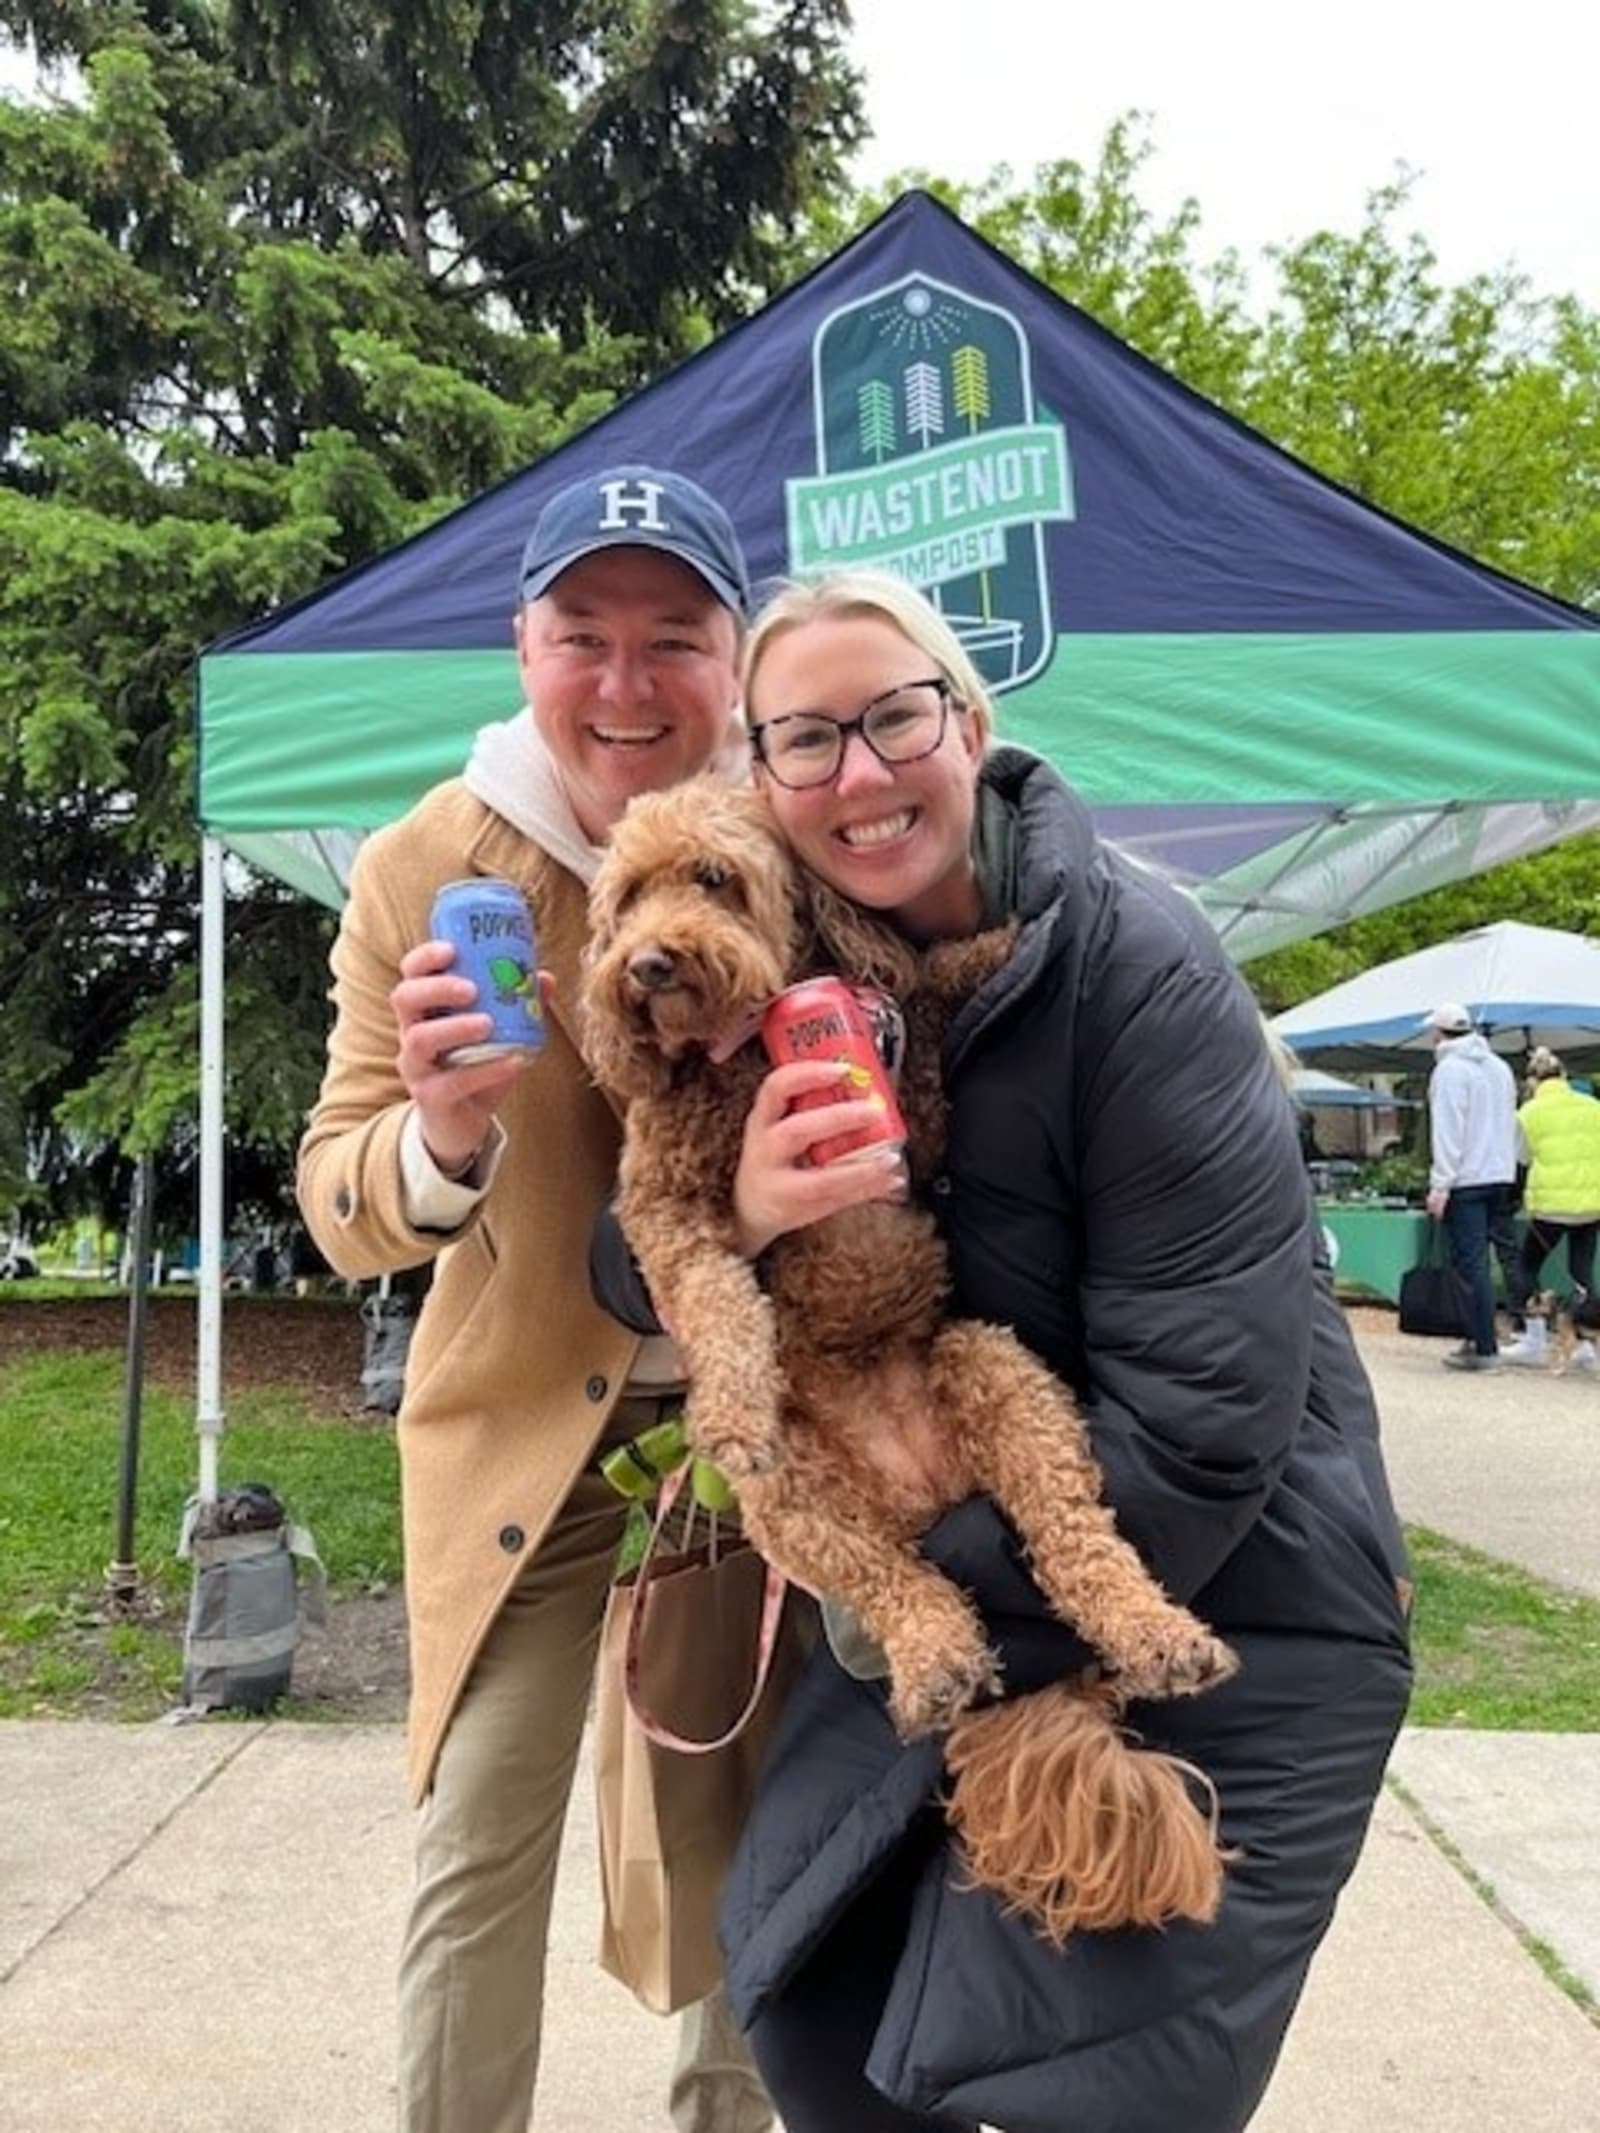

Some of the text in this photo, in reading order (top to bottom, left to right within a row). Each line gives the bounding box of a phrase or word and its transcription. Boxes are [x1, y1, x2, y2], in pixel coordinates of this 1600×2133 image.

[599, 479, 669, 531] H
[808, 445, 1048, 551] WASTENOT
[876, 527, 995, 583] OMPOST
